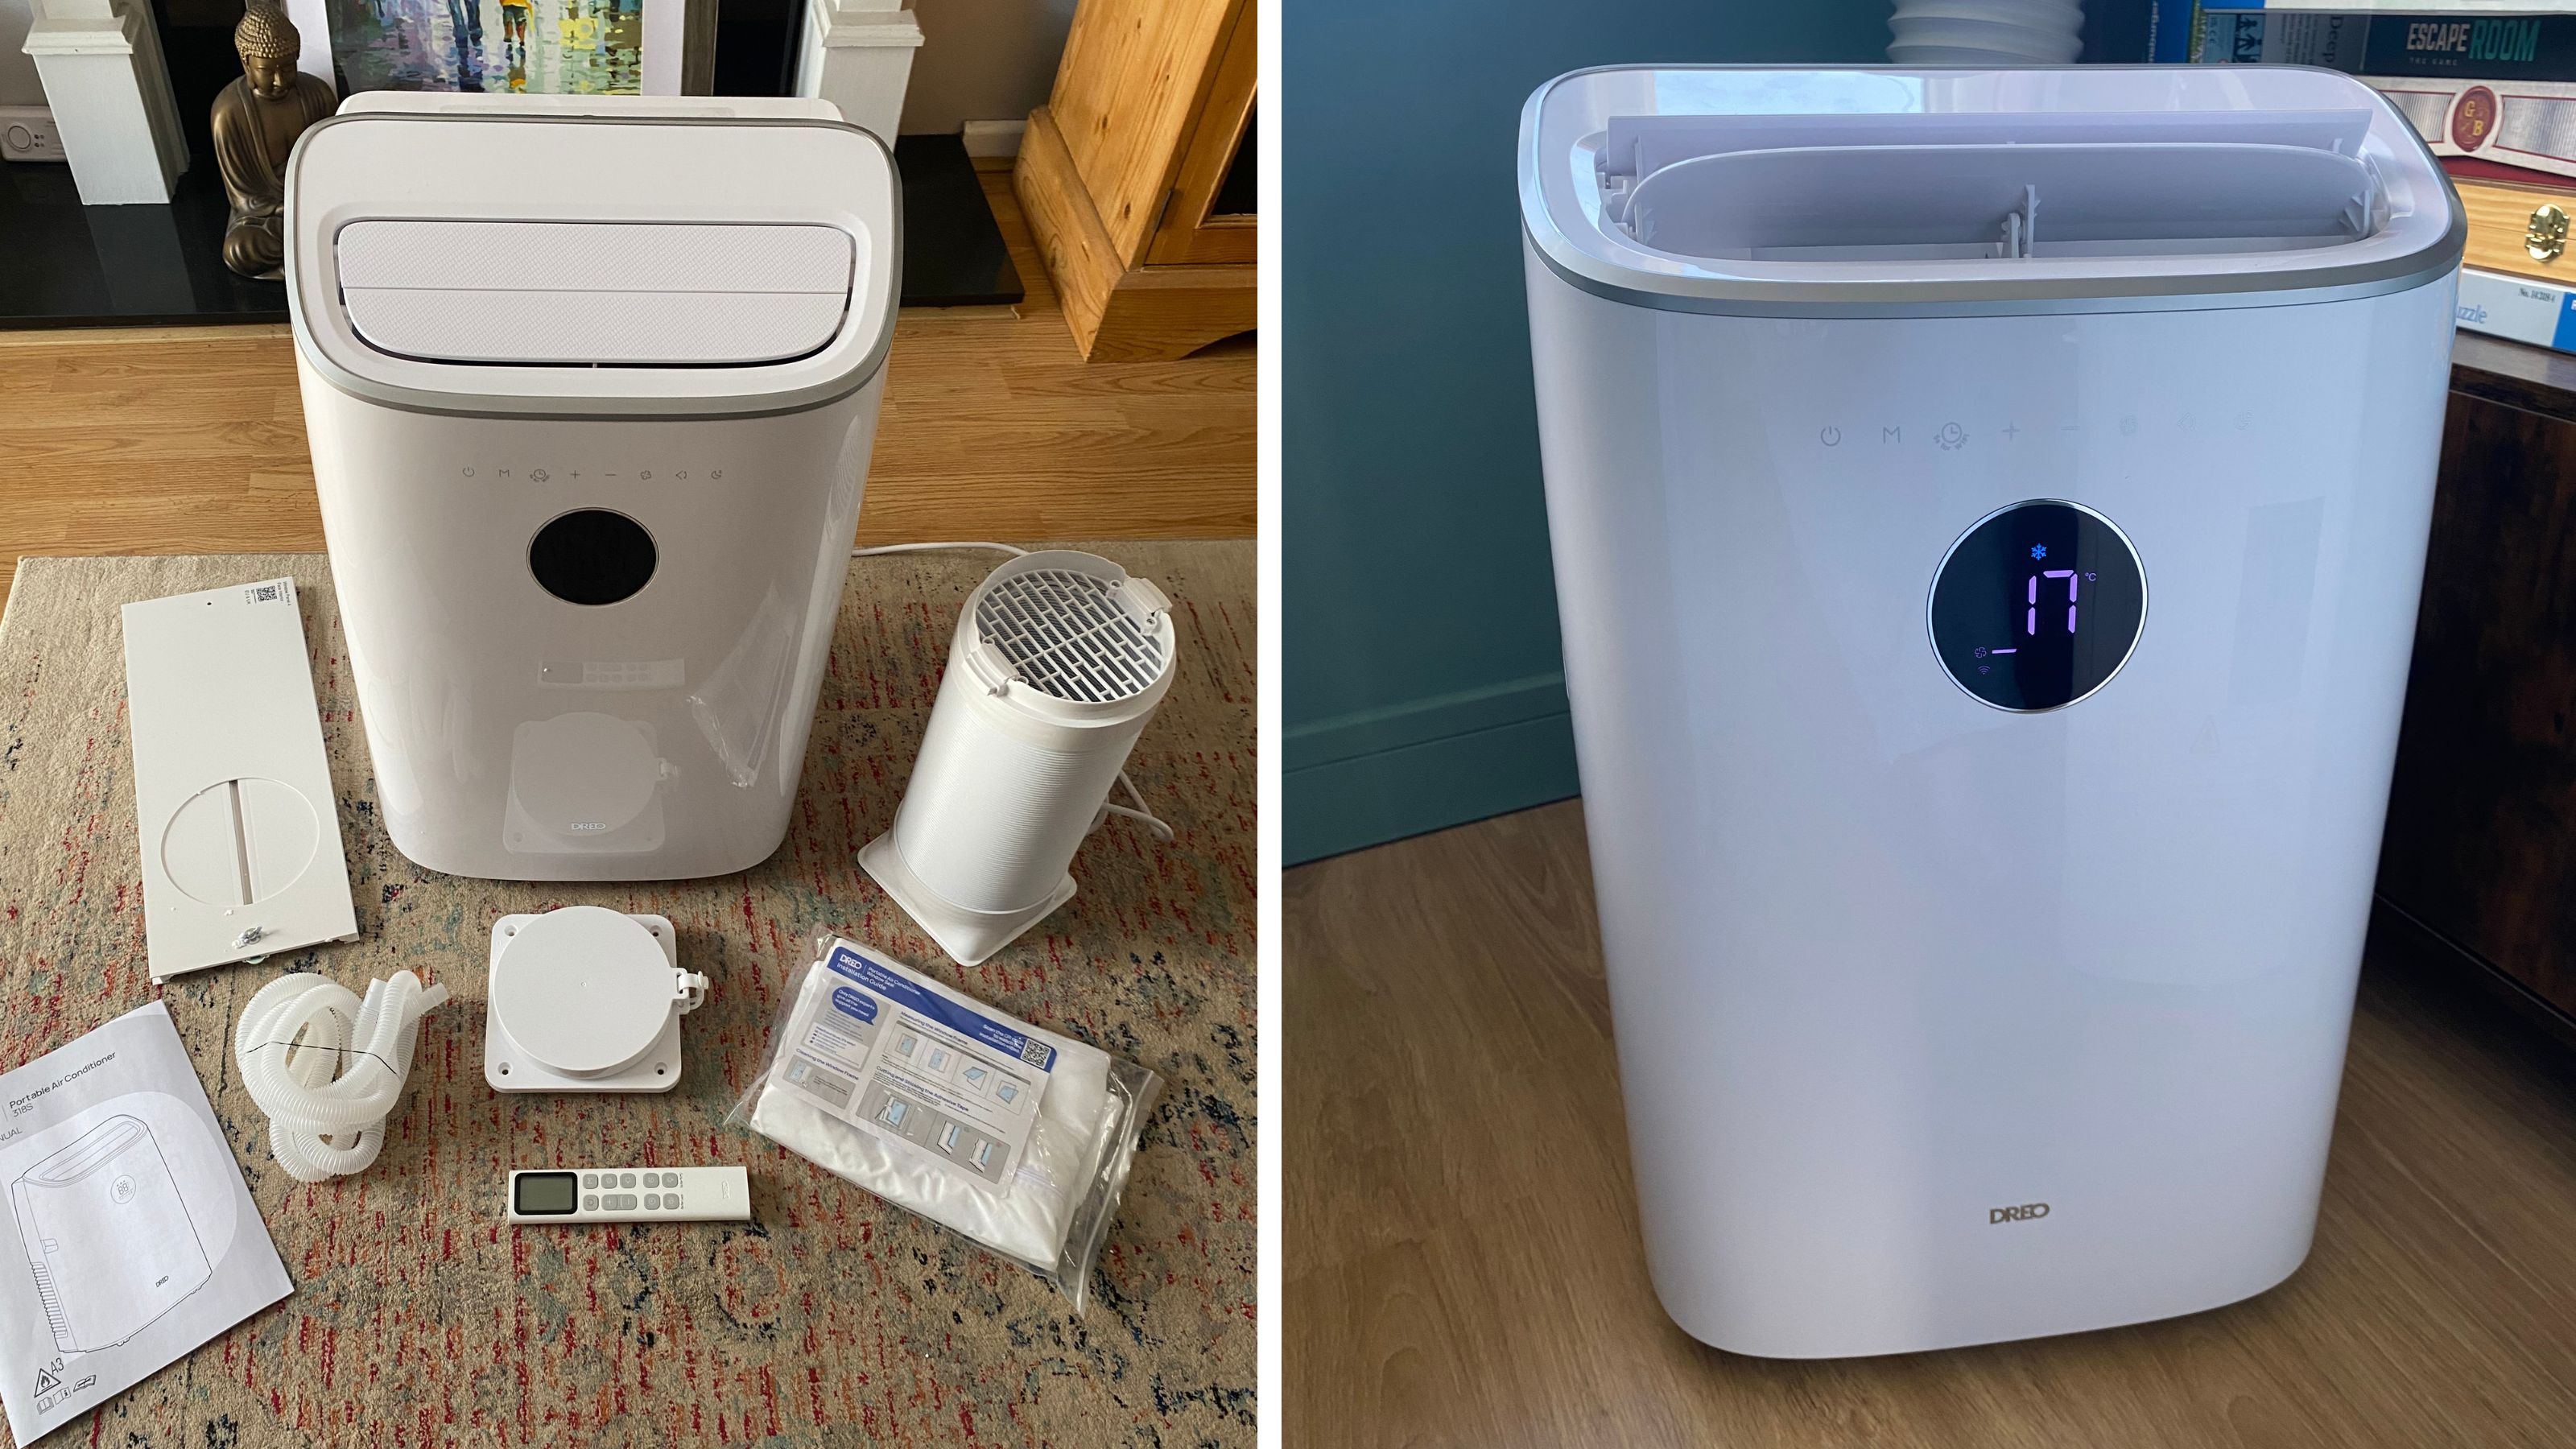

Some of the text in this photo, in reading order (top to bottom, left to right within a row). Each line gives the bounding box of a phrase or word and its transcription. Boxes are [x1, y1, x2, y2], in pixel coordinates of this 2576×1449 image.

[2322, 16, 2343, 63] Deep
[2406, 19, 2541, 62] ESCAPE ROOM
[1883, 426, 1901, 444] M
[2028, 569, 2078, 635] 17
[571, 822, 606, 831] DREO
[839, 954, 862, 970] DREO
[836, 962, 887, 990] Installation Guide
[866, 971, 884, 982] Window
[868, 967, 887, 978] Portable
[894, 980, 921, 995] Conditioner
[10, 1051, 116, 1108] Portable Air Conditioner
[876, 1065, 894, 1077] Cutting
[12, 1103, 33, 1117] 318S
[1990, 1203, 2050, 1224] DREO
[155, 1275, 169, 1287] DREO
[51, 1357, 64, 1375] A3
